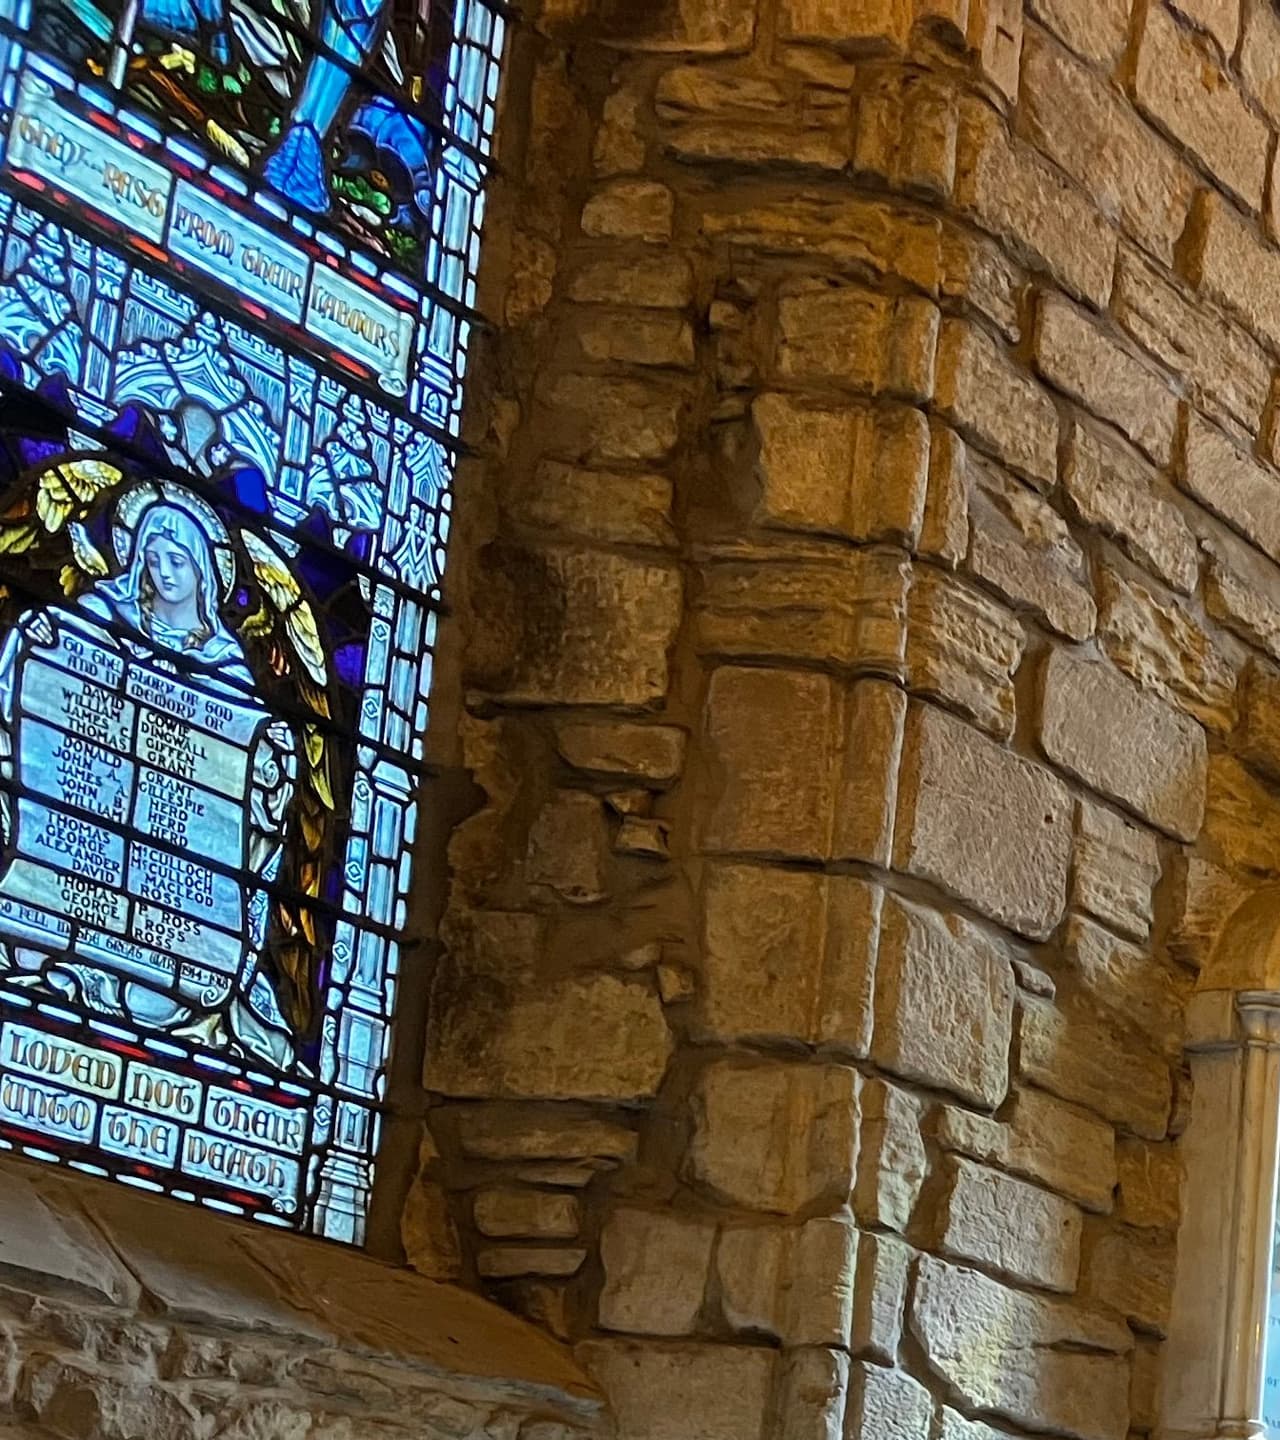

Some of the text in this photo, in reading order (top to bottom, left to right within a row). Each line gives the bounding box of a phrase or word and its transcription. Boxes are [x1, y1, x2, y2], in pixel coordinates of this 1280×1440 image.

[61, 705, 110, 731] JAMES
[62, 687, 208, 760] WILLIAM DINGWALL
[82, 682, 191, 736] DAVID COWIE
[63, 736, 195, 798] DONALD GRANT
[67, 717, 198, 780] THOMAS GRANT
[52, 747, 93, 771] JOHN
[139, 782, 206, 817] GILLESPIE
[56, 763, 104, 787] JAMES
[149, 799, 189, 823] HERD
[56, 777, 98, 800] JOHN
[148, 813, 187, 835] HERD
[46, 811, 111, 844] THOMAS
[46, 825, 107, 856] GEORGE
[62, 789, 189, 848] WILLIAM HERD
[35, 834, 214, 907] ALEXANDER MACLEOD
[72, 861, 183, 909] DAVID ROSS
[55, 872, 119, 905] THOMAS
[162, 913, 202, 937] ROSS
[61, 890, 187, 943] GEORGE ROSS
[64, 903, 173, 950] JOHN ROSS
[10, 1030, 301, 1150] LOVED NOT THEIR
[2, 1075, 287, 1190] UNTO THE DEATH
